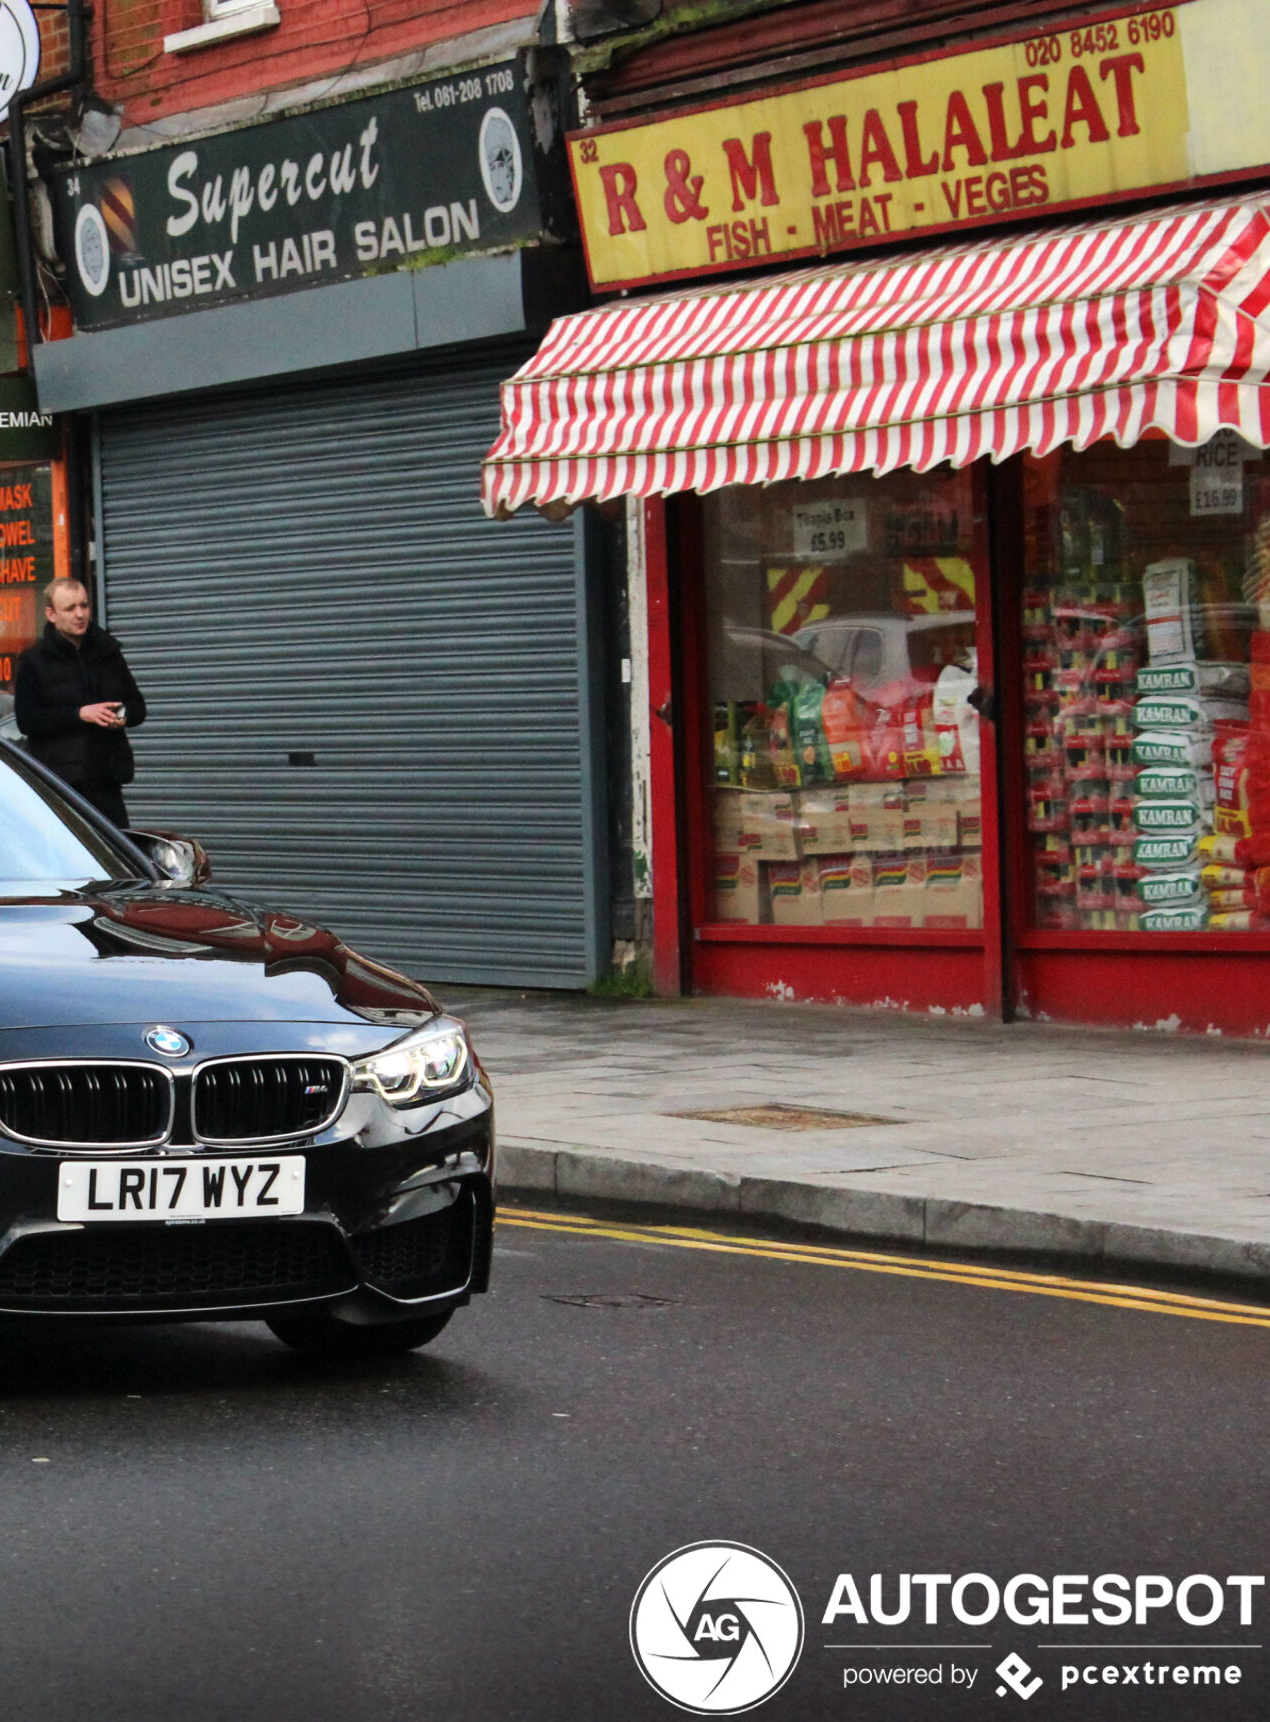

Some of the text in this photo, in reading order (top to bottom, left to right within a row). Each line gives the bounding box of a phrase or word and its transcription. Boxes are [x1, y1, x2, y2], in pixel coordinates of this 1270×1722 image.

[1025, 11, 1174, 67] 020 8452 6190
[434, 78, 482, 107] 081-208
[485, 69, 514, 95] 1708
[580, 139, 598, 164] 32
[599, 53, 1144, 236] R & M HALALEAT
[67, 178, 81, 196] 34
[166, 116, 379, 244] Supercut
[706, 217, 771, 262] FISH
[812, 193, 892, 246] MEAT
[941, 164, 1049, 219] VEGES
[119, 200, 480, 308] UNISEX HAIR SALON
[1195, 443, 1238, 466] RICE
[1137, 671, 1192, 690] KAMRAN
[1136, 705, 1191, 723] KAMRAN
[1138, 809, 1193, 825] KAMRAN
[1136, 842, 1188, 858] KAMRAN
[1143, 881, 1193, 900] KAMRAN
[88, 1163, 280, 1211] LR17 WYZ
